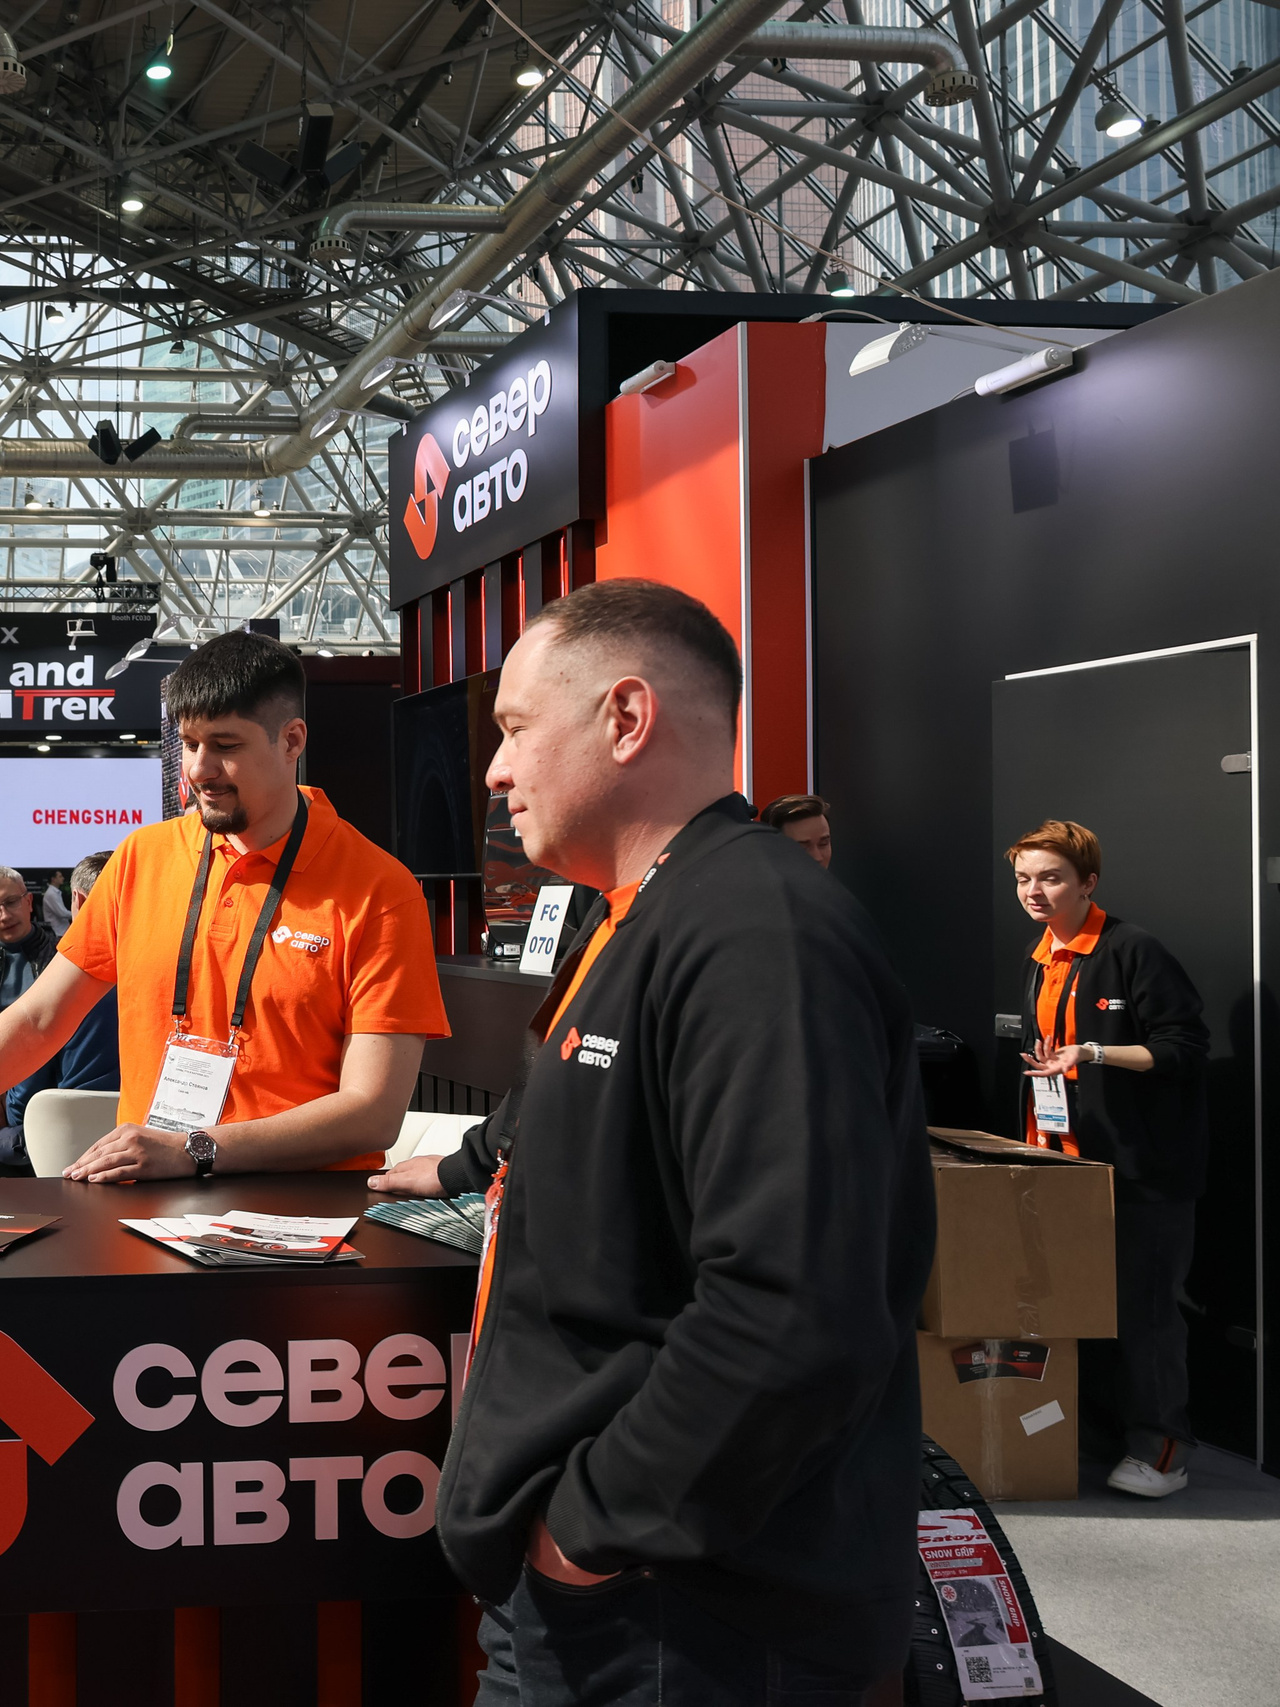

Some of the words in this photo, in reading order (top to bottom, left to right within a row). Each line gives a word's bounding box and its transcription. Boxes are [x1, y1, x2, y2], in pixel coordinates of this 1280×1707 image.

[452, 359, 552, 469] север
[452, 448, 528, 533] авто
[32, 809, 143, 825] CHENGSHAN
[540, 904, 560, 922] FC
[290, 939, 319, 953] авто
[294, 930, 330, 948] север
[529, 936, 554, 955] 070
[577, 1049, 612, 1069] авто
[113, 1332, 473, 1431] севе
[116, 1450, 442, 1550] авто
[917, 1533, 987, 1544] Satoya
[924, 1548, 953, 1560] SNOW
[954, 1546, 976, 1558] GRIP
[998, 1579, 1012, 1608] SNOW
[1008, 1608, 1021, 1628] GRIP
